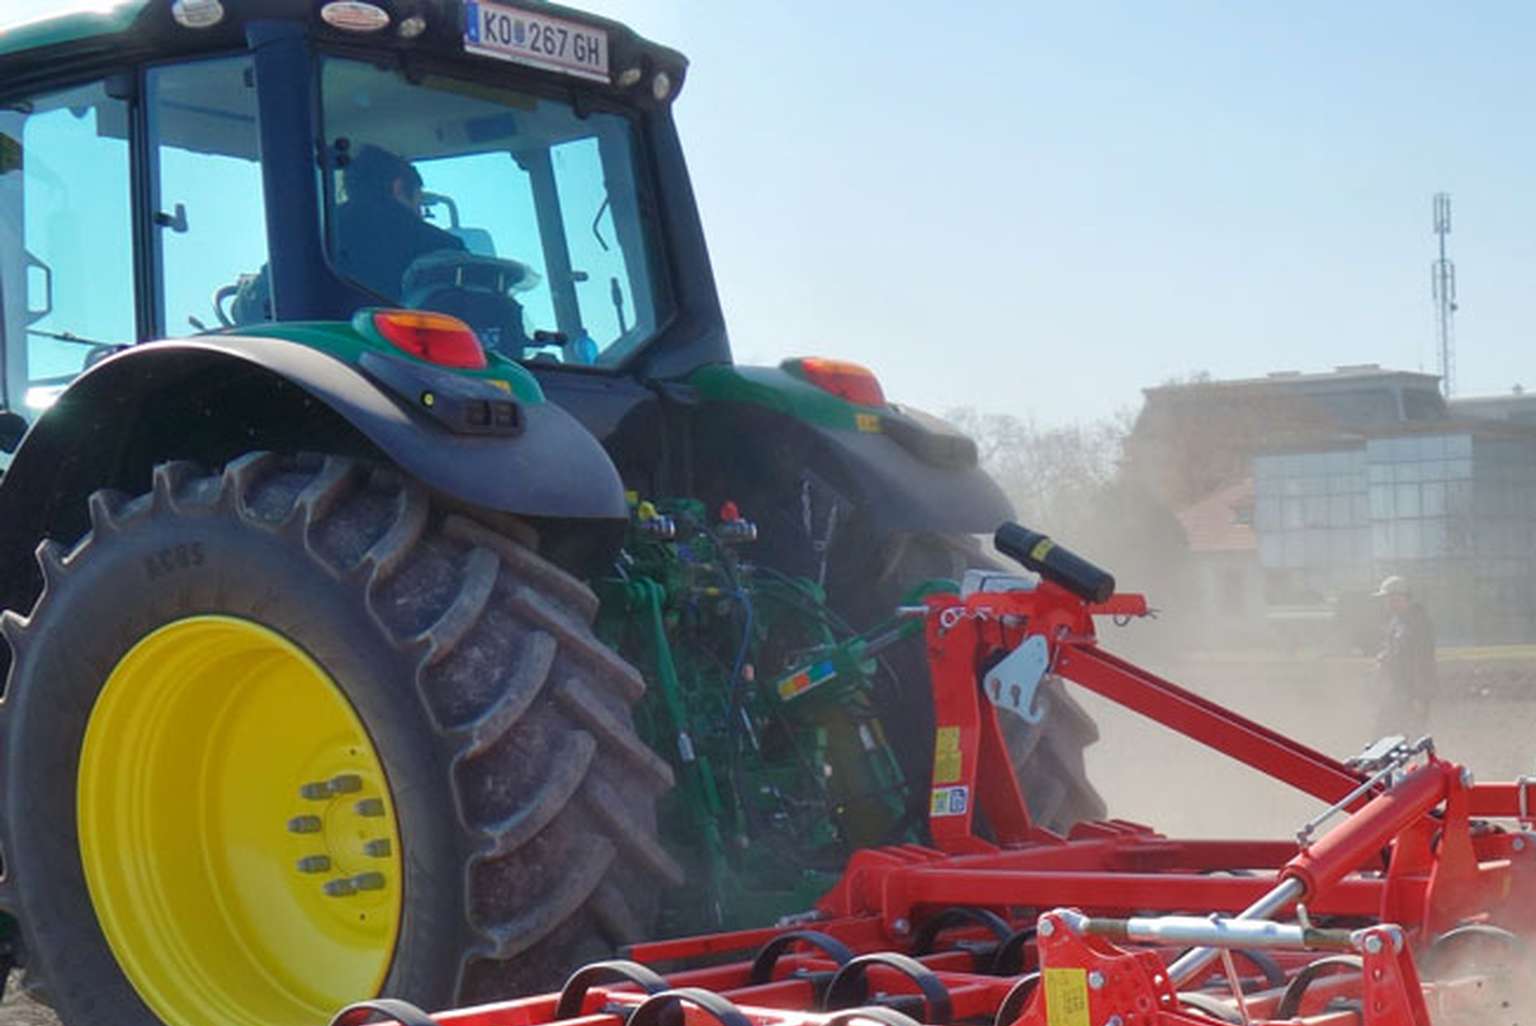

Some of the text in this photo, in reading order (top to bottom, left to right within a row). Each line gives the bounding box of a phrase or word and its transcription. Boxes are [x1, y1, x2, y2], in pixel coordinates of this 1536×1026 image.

[484, 10, 600, 66] KO 267 GH
